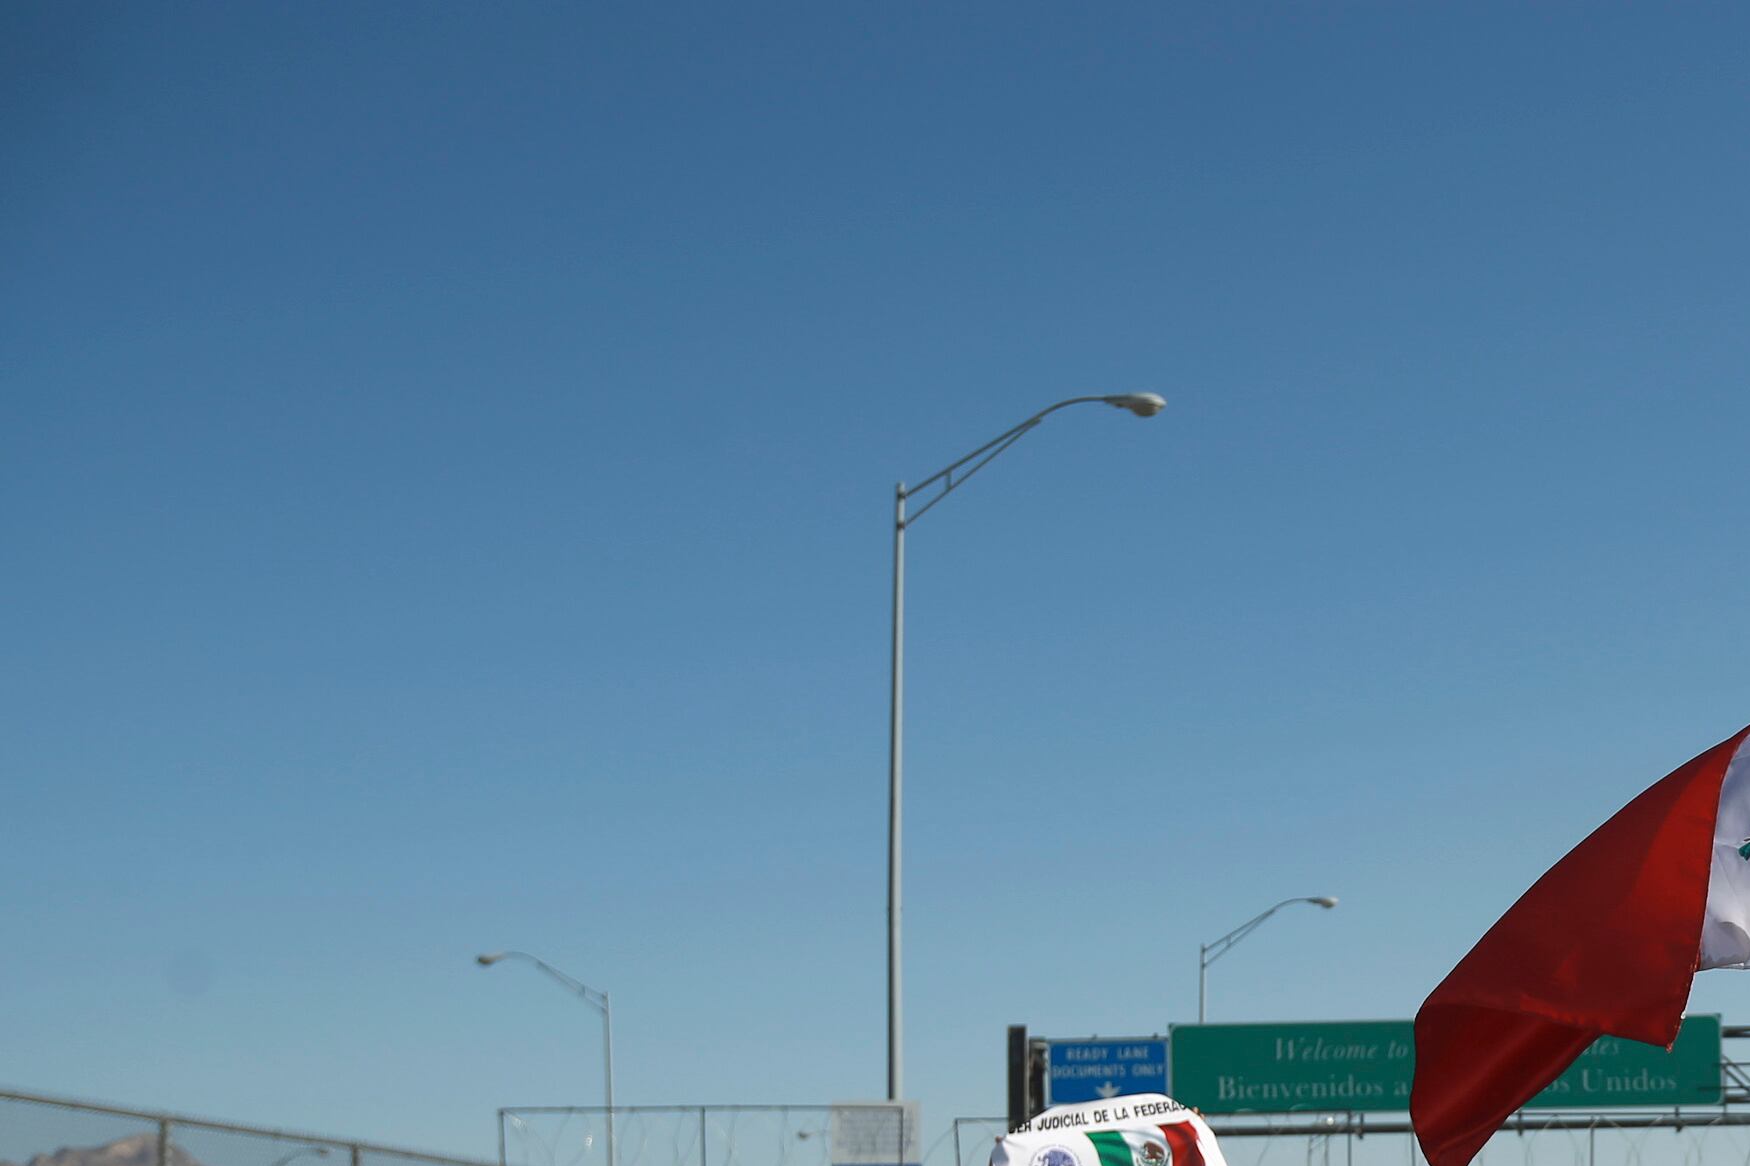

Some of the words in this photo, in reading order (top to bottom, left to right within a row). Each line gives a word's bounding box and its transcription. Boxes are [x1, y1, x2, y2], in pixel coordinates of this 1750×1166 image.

[1066, 1047, 1107, 1060] READY
[1117, 1046, 1148, 1060] LANE
[1274, 1037, 1377, 1061] Welcome
[1387, 1040, 1409, 1060] to
[1052, 1064, 1126, 1078] DOCUMENTS
[1132, 1062, 1164, 1077] ONLY
[1218, 1074, 1384, 1101] Bienvenidos
[1582, 1068, 1677, 1093] Unidos
[1037, 1111, 1089, 1131] JUDICIAL
[1094, 1108, 1110, 1123] DE
[1114, 1107, 1130, 1121] LA
